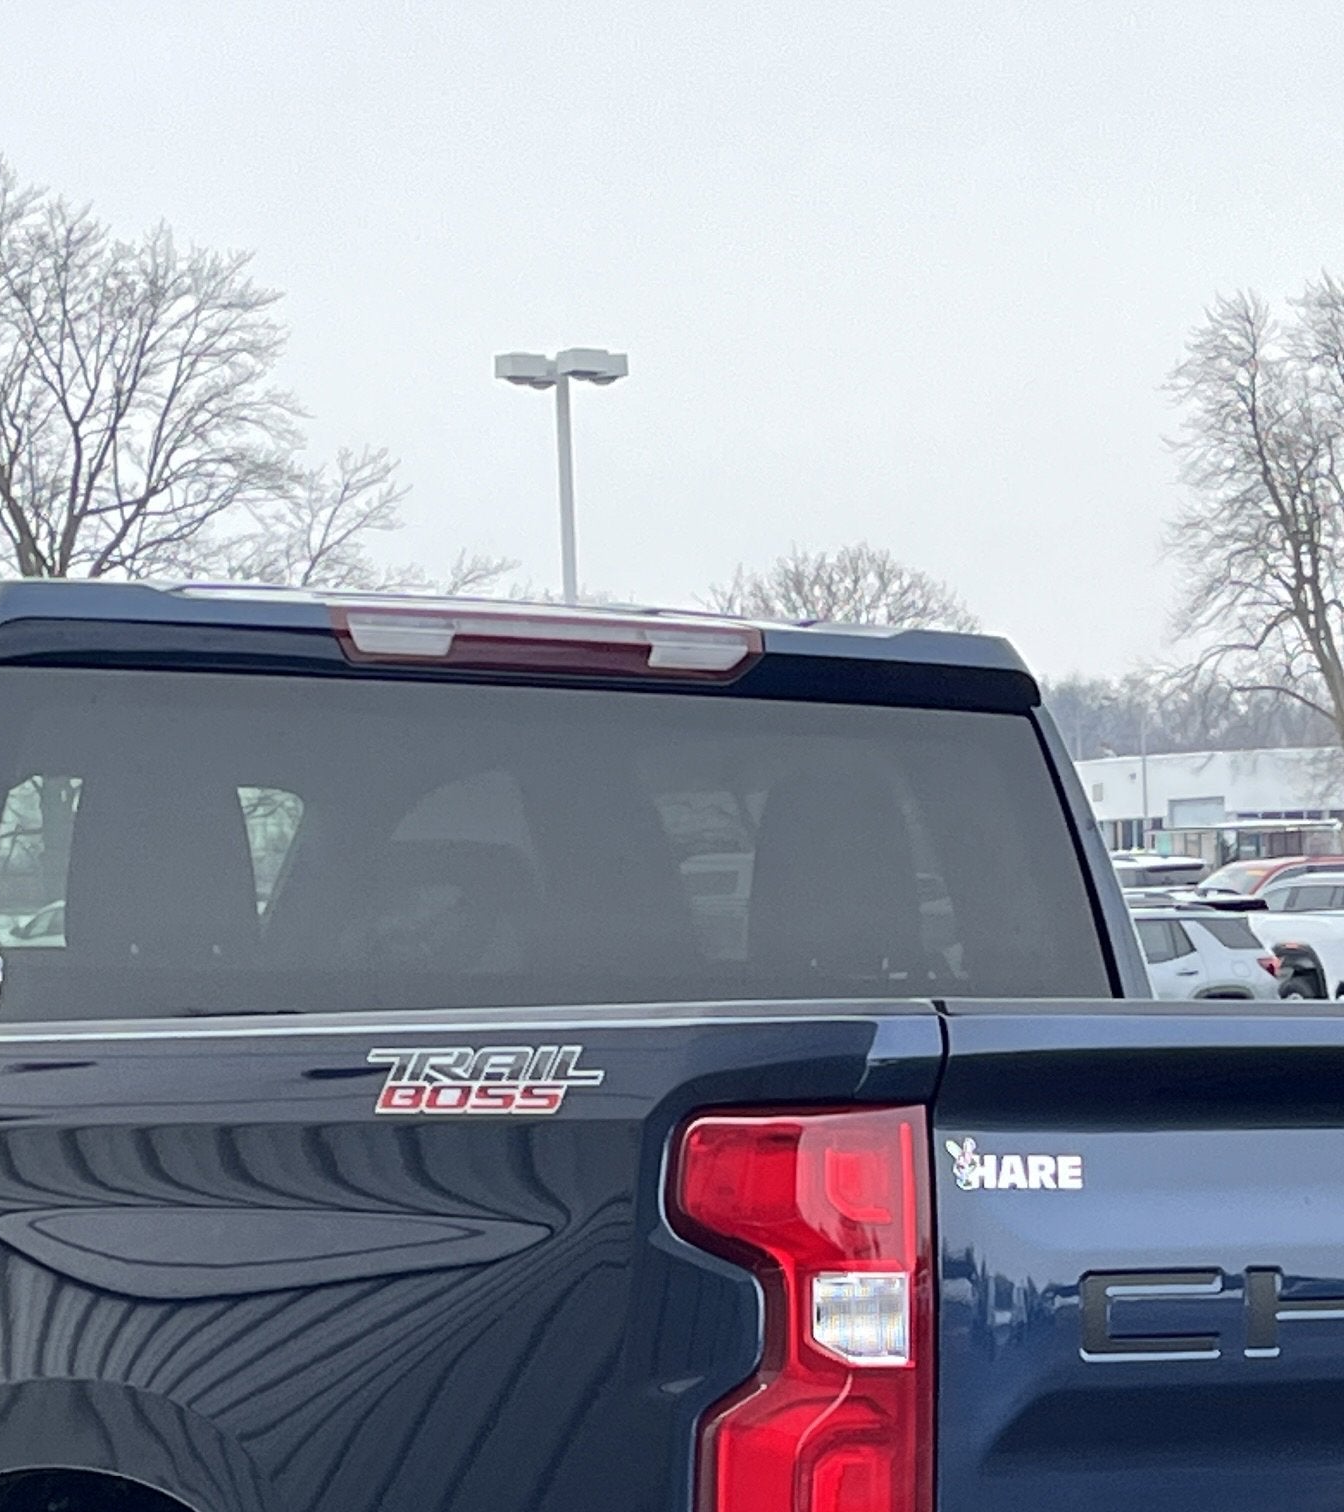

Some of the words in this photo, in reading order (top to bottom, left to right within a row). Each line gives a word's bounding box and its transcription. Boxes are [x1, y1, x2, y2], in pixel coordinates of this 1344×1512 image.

[367, 1045, 605, 1085] TRAIL
[375, 1082, 568, 1114] BOSS
[969, 1154, 1083, 1189] HARE
